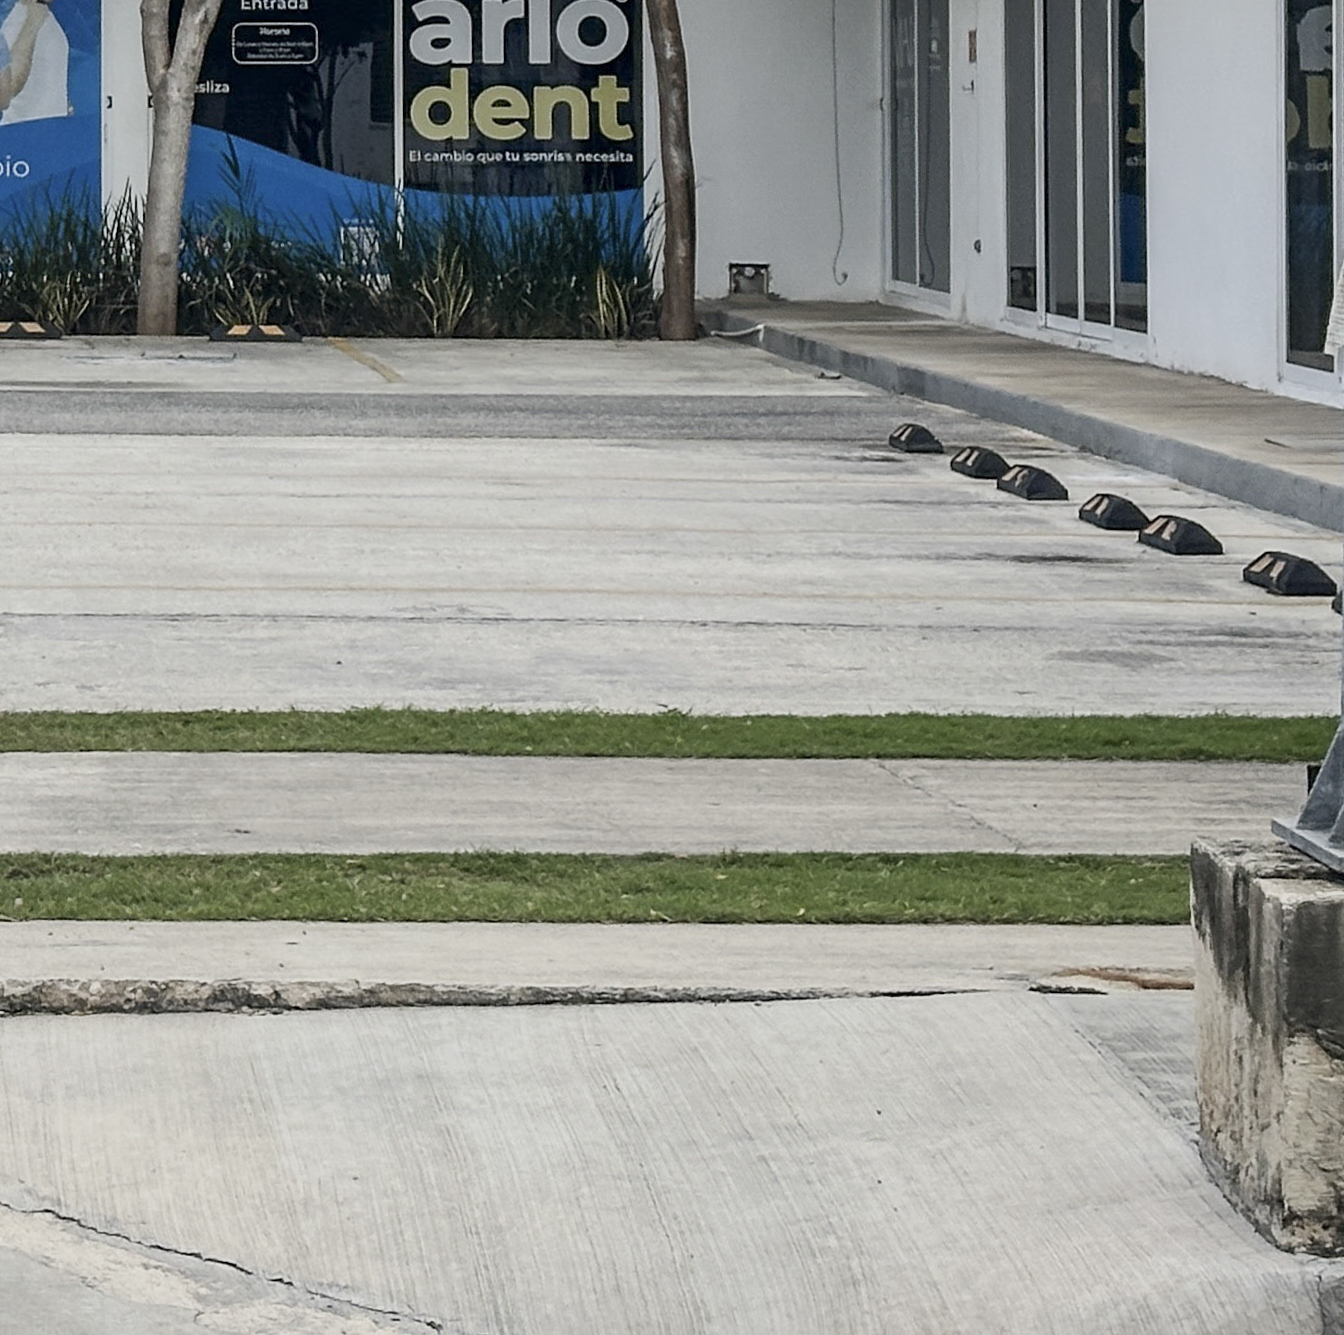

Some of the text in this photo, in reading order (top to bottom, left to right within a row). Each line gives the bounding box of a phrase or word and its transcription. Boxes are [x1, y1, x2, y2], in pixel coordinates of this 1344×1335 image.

[410, 67, 634, 141] dent
[409, 150, 422, 162] El
[424, 150, 474, 162] cambio
[476, 152, 502, 165] que
[505, 150, 520, 162] tu
[575, 150, 634, 163] necesita
